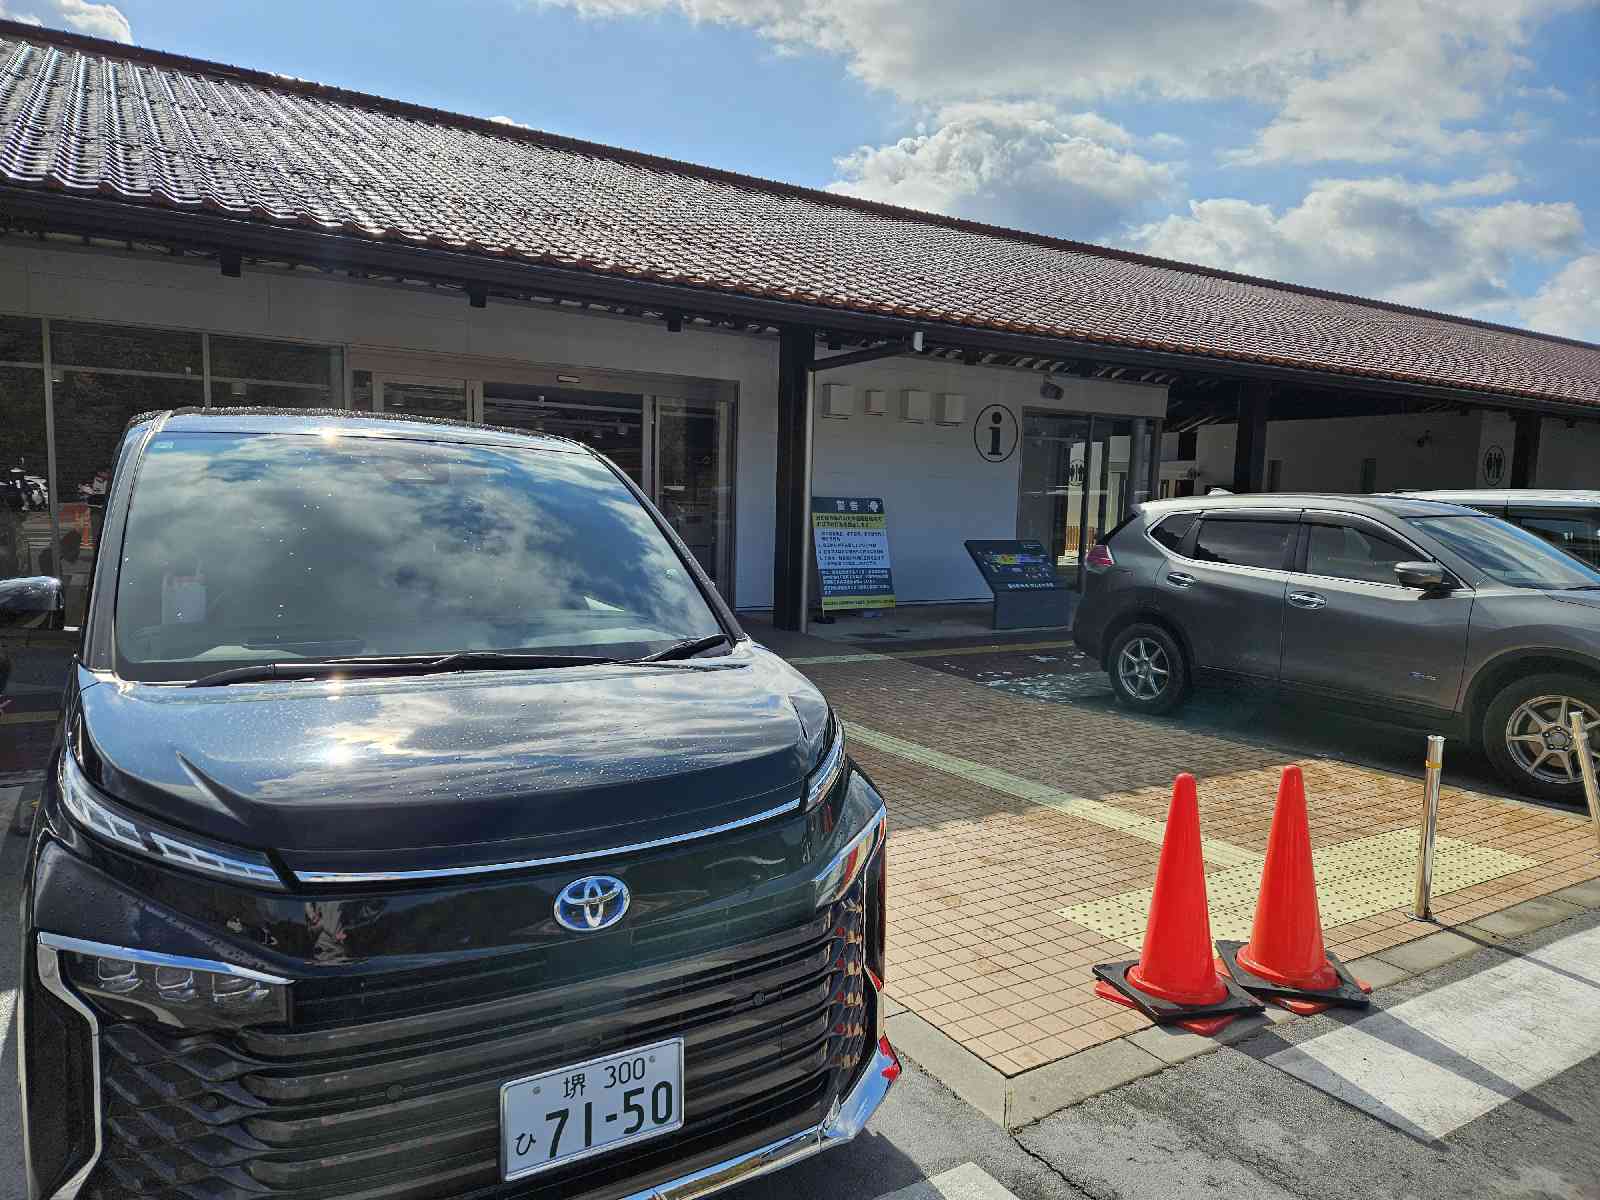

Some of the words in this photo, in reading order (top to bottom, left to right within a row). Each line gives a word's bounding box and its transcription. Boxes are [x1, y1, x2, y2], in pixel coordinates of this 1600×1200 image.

[988, 411, 1003, 456] i
[563, 1072, 586, 1100] 堺
[603, 1057, 646, 1089] 300
[514, 1132, 537, 1156] ひ
[545, 1080, 673, 1159] 71-50
